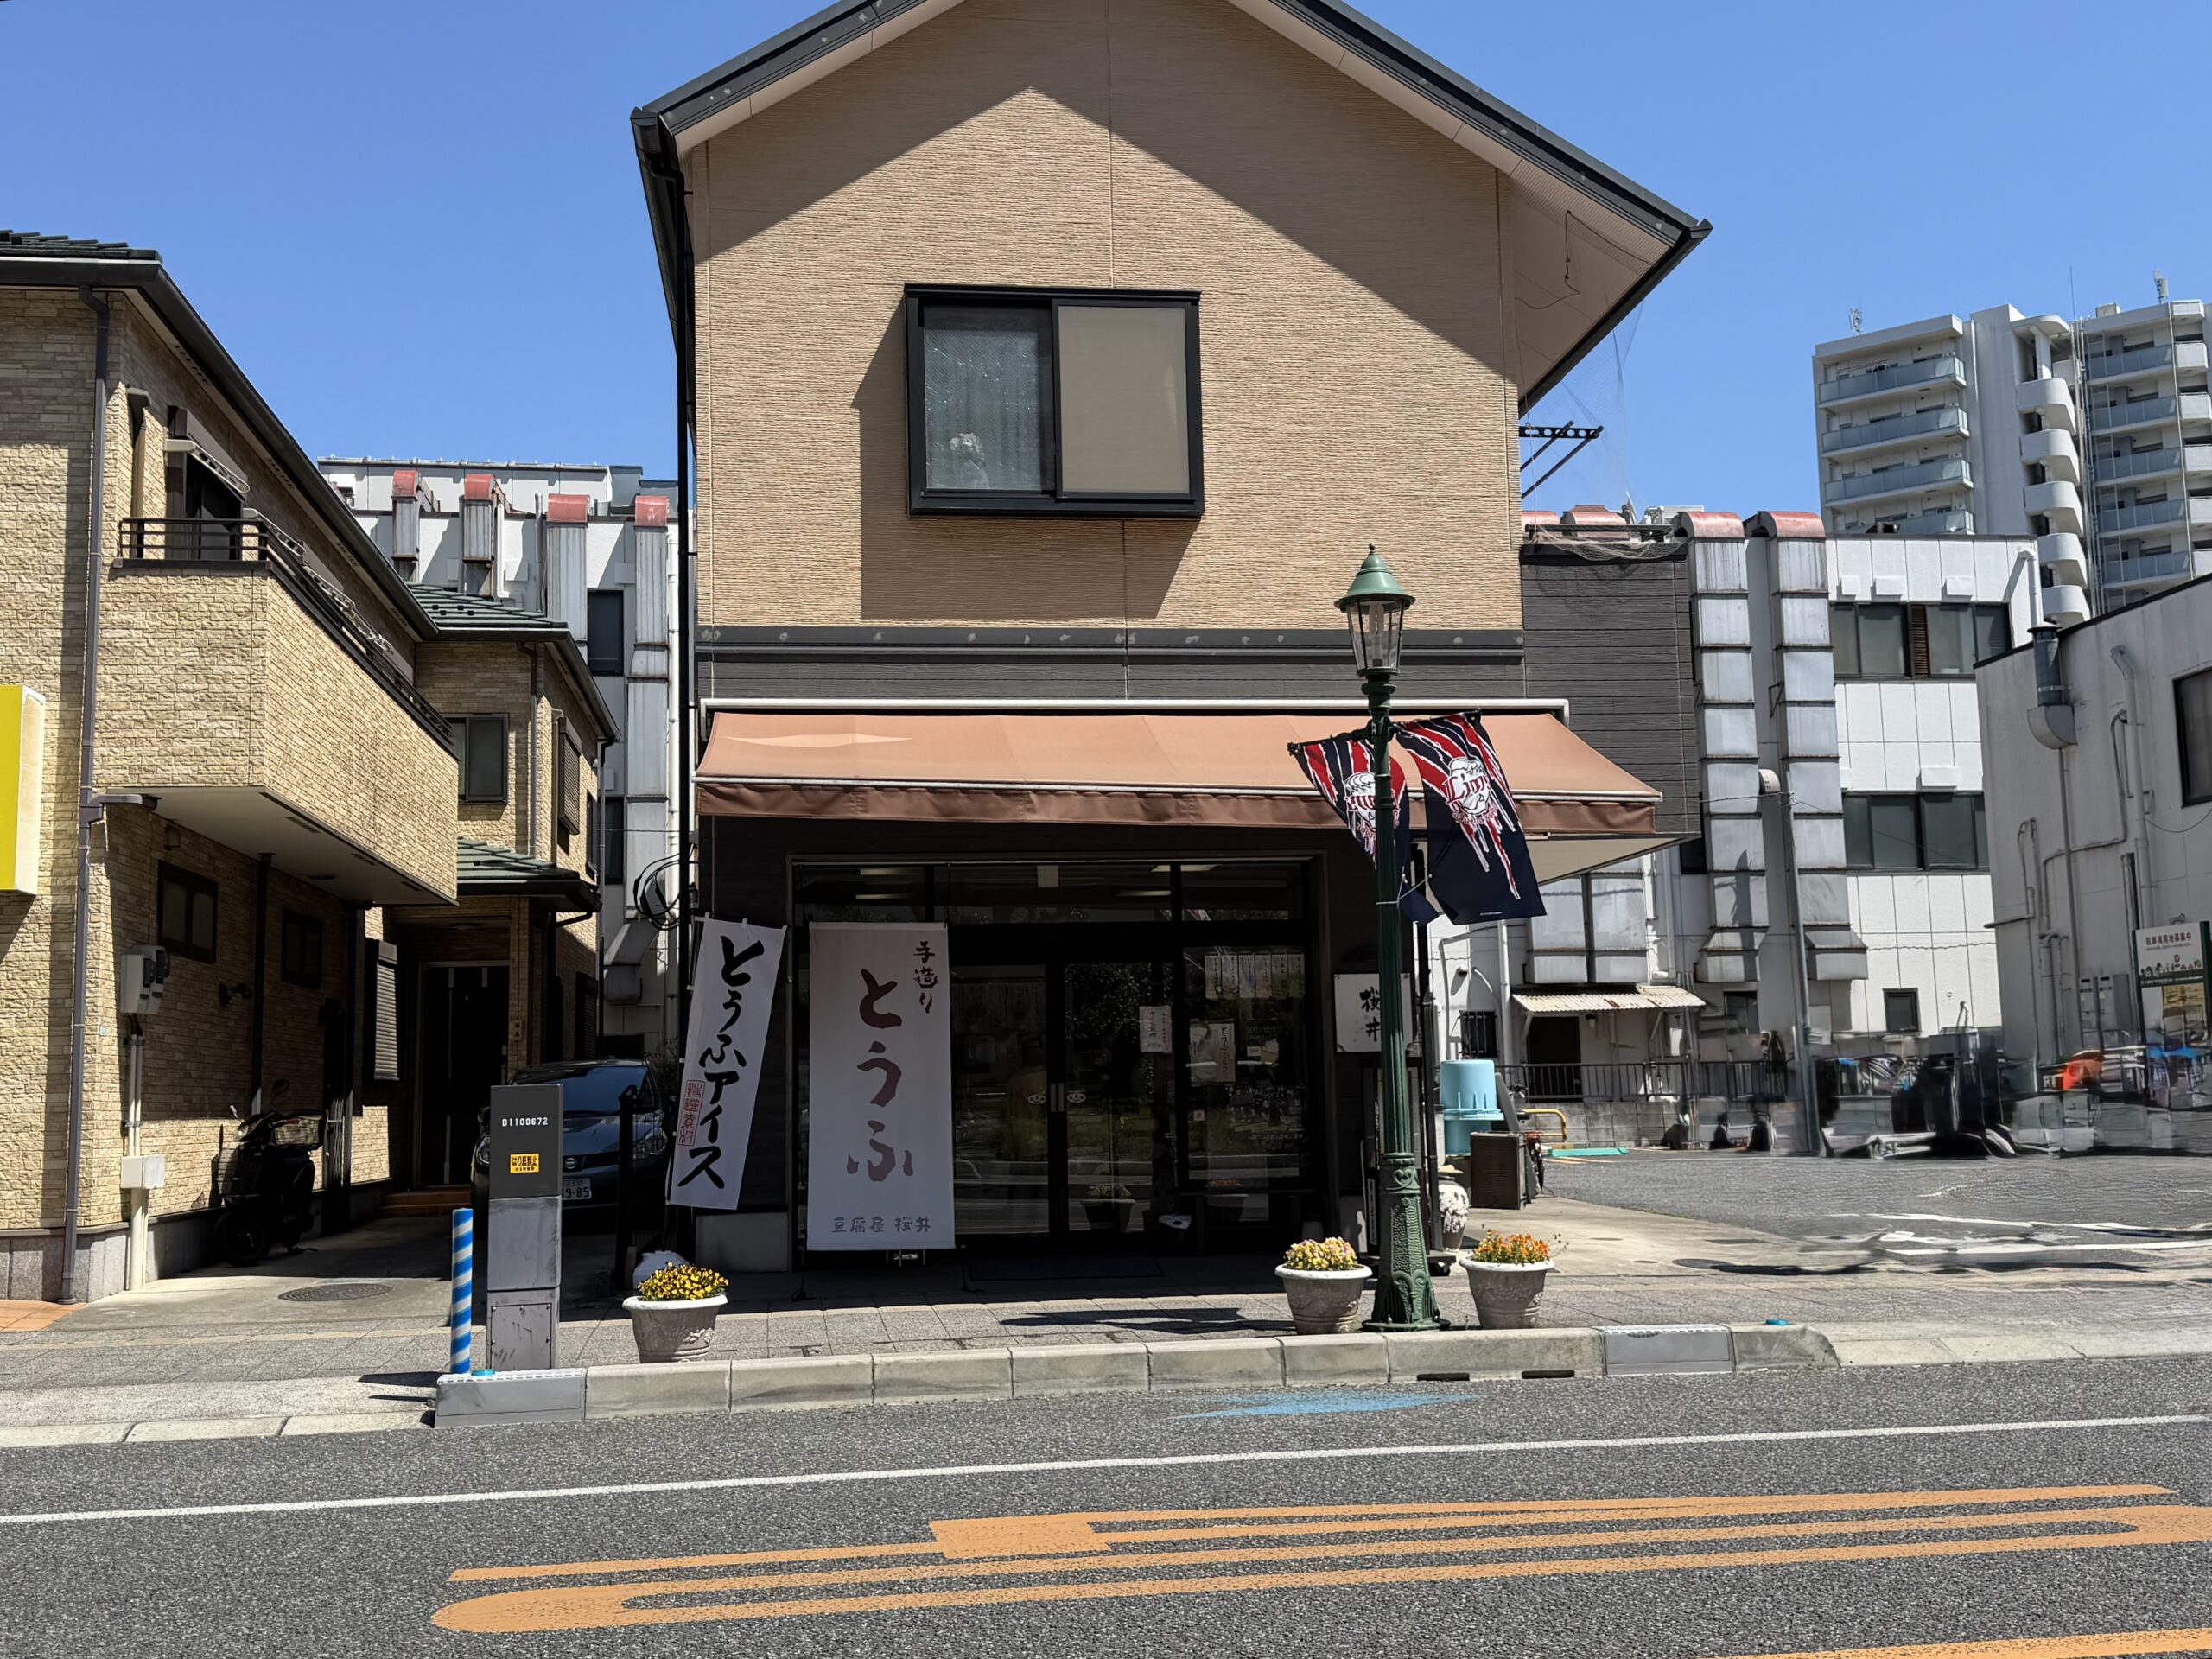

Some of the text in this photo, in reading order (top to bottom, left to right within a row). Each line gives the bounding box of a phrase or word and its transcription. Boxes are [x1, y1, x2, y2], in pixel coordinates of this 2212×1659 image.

[913, 940, 938, 1014] 手造り
[678, 935, 765, 1189] とうふアイス
[847, 968, 914, 1182] とうふ
[501, 1116, 549, 1127] D1100672
[831, 1216, 886, 1233] 豆腐屋
